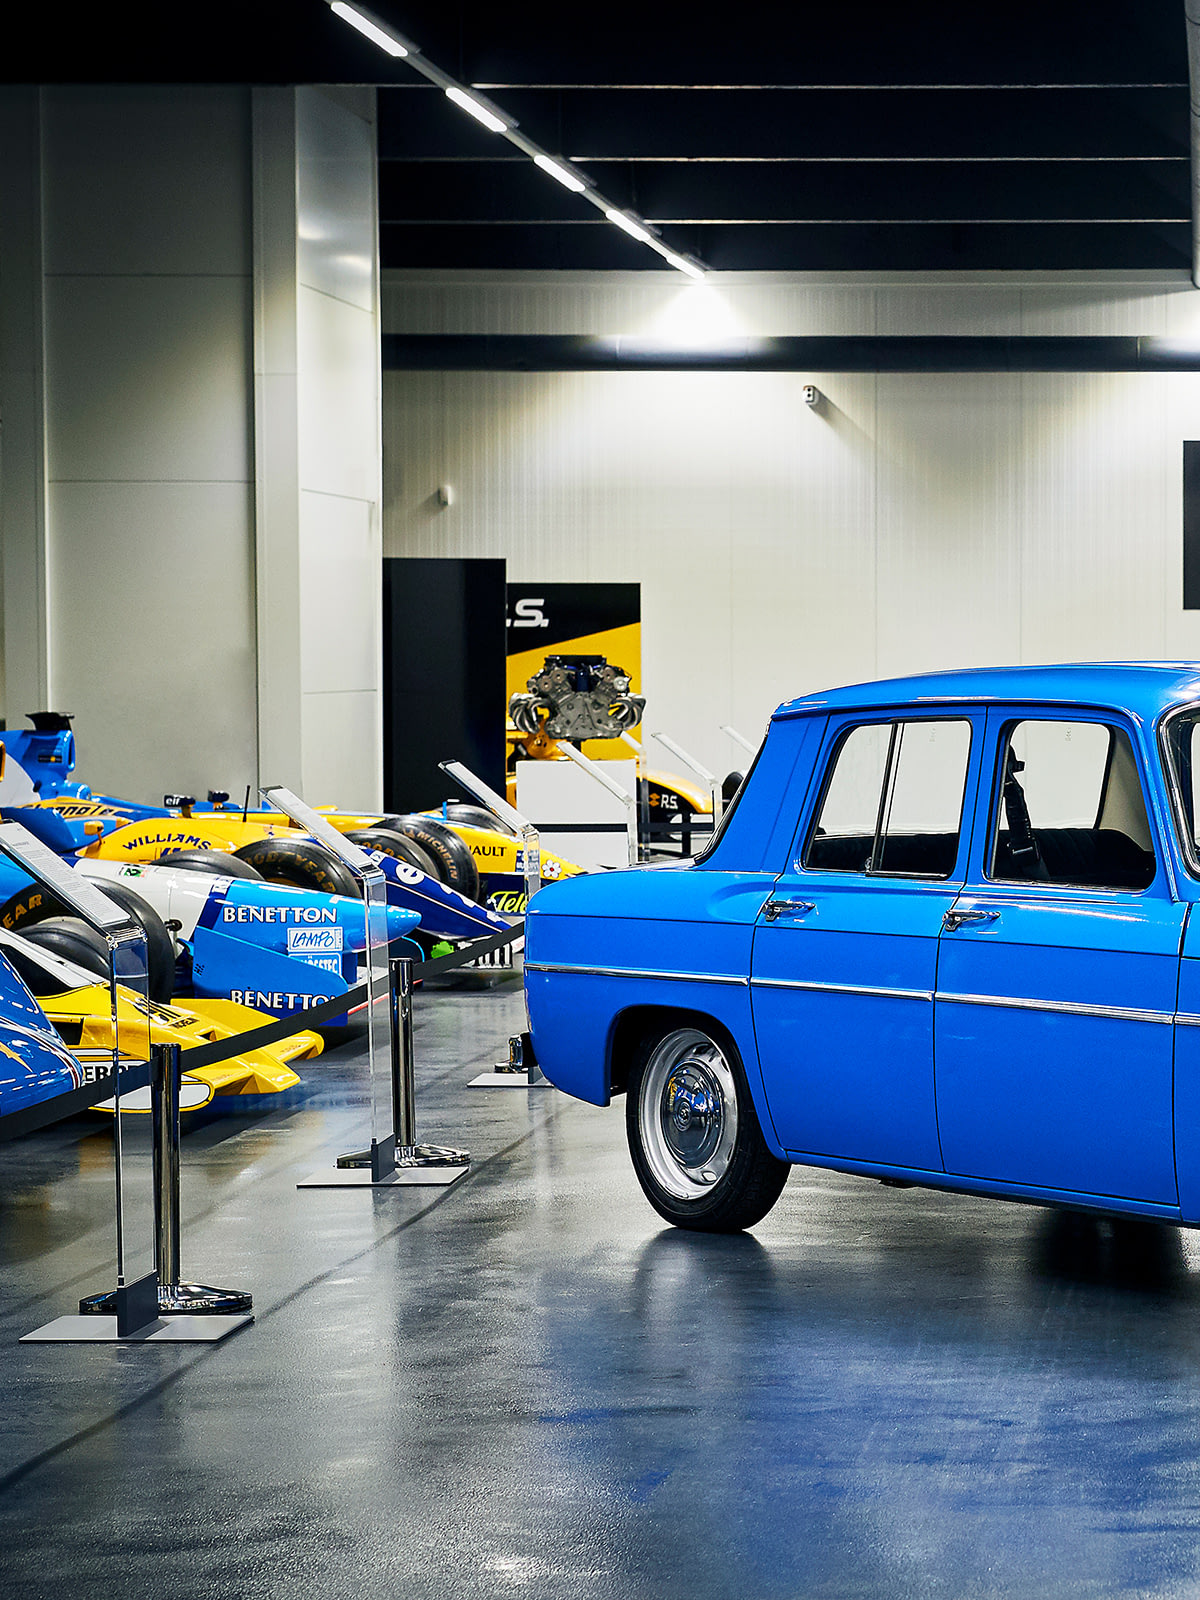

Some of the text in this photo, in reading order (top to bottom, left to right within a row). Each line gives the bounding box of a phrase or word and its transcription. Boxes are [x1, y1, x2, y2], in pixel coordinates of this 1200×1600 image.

[122, 833, 212, 851] WILLIAMS
[417, 830, 459, 880] MICHELIN
[469, 846, 507, 857] AULT
[223, 907, 337, 923] BENETTON
[292, 931, 334, 948] LAMPO
[230, 989, 336, 1010] BENETTO
